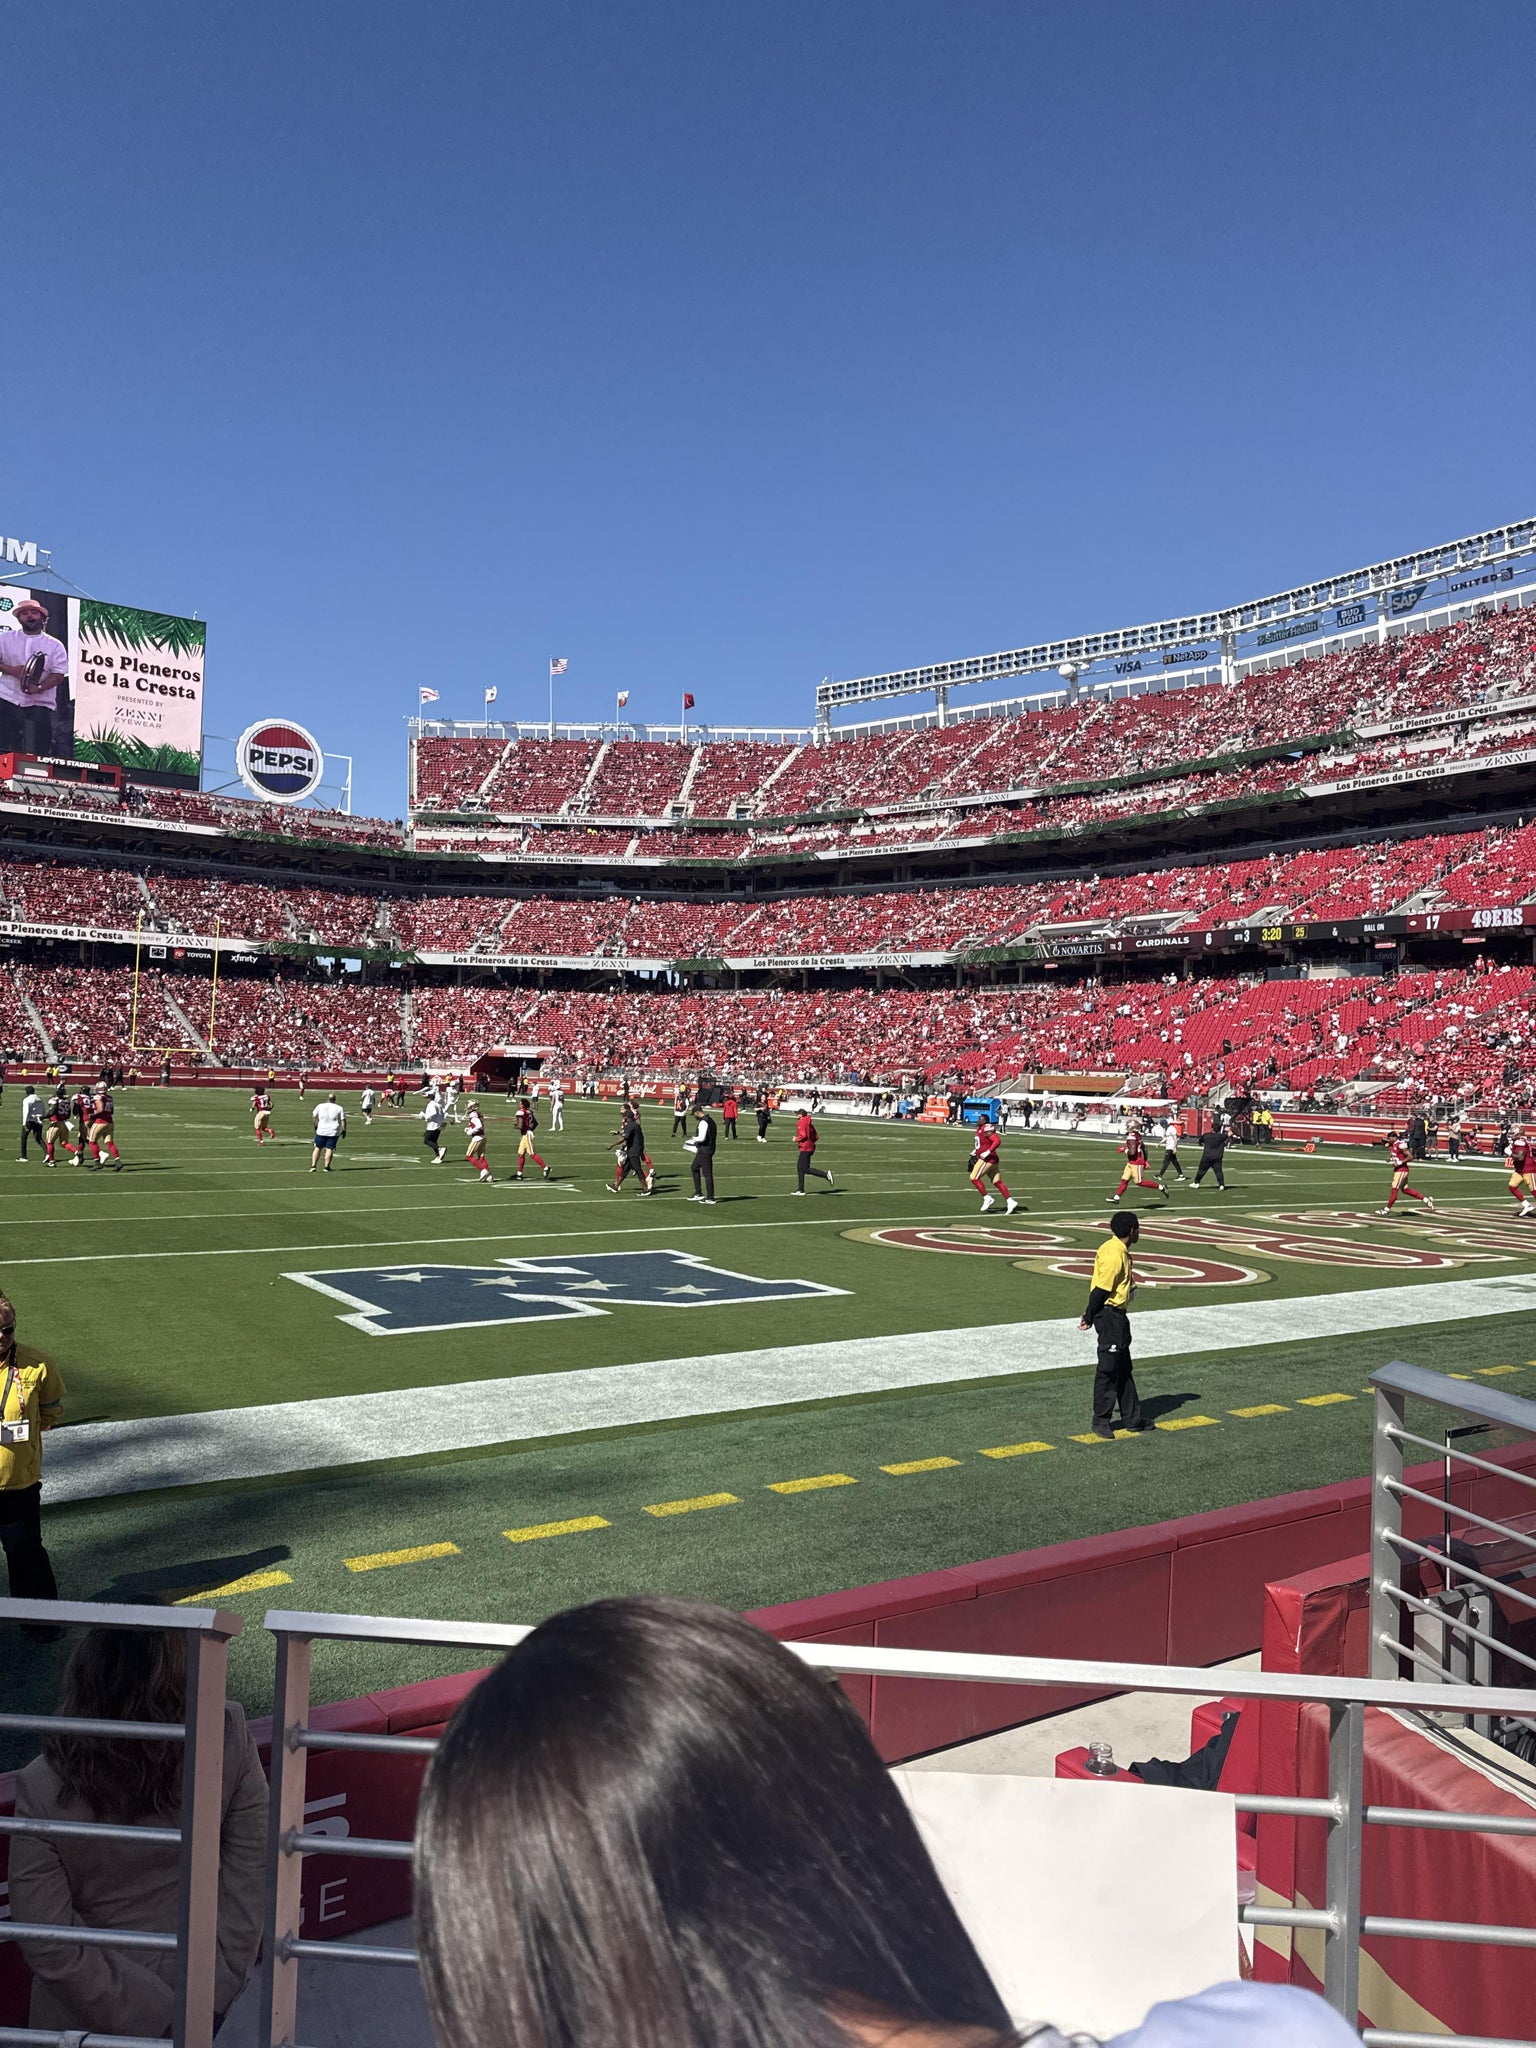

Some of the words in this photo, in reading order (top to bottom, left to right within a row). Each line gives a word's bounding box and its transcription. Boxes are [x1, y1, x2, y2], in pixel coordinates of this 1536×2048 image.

[1451, 574, 1498, 592] UNITED
[1392, 593, 1418, 609] SAP
[1338, 614, 1364, 627] LIGHT
[1341, 608, 1360, 618] BUD
[1172, 650, 1207, 662] NetApp
[81, 649, 114, 668] Los
[120, 656, 201, 682] Pleneros
[1114, 660, 1142, 674] VISA
[84, 669, 107, 685] de
[112, 673, 130, 689] la
[136, 678, 196, 700] Cresta
[117, 695, 154, 706] PRESENTED
[115, 706, 162, 722] ZENNI
[1389, 723, 1404, 731] Los
[1406, 716, 1442, 728] Pleneros
[1468, 704, 1498, 716] Cresta
[114, 716, 162, 729] EYEWEAR
[66, 760, 99, 770] STADIUM
[250, 749, 313, 772] PEPSI
[1352, 776, 1390, 788] Pleneros
[1416, 767, 1446, 778] Cresta
[28, 806, 42, 814] Los
[44, 808, 78, 818] Pleneros
[80, 812, 90, 820] de
[100, 815, 126, 824] Cresta
[11, 924, 58, 936] Pleneros
[62, 928, 74, 936] de
[77, 929, 87, 937] la
[90, 930, 124, 940] Cresta
[1136, 936, 1190, 948] CARDINALS
[1206, 933, 1212, 945] 6
[1244, 930, 1250, 942] 3
[1262, 928, 1282, 941] 3:20
[1295, 927, 1305, 938] 25
[1332, 927, 1338, 936] &
[1364, 924, 1376, 932] BALL
[1426, 915, 1440, 930] 17
[1471, 908, 1523, 928] 49ERS
[1061, 944, 1102, 955] NOVARTIS
[230, 954, 258, 964] xfinity
[470, 956, 506, 964] Pleneros
[530, 958, 558, 966] Cresta
[767, 958, 799, 967] Pleneros
[800, 958, 810, 966] de
[820, 957, 845, 966] Cresta
